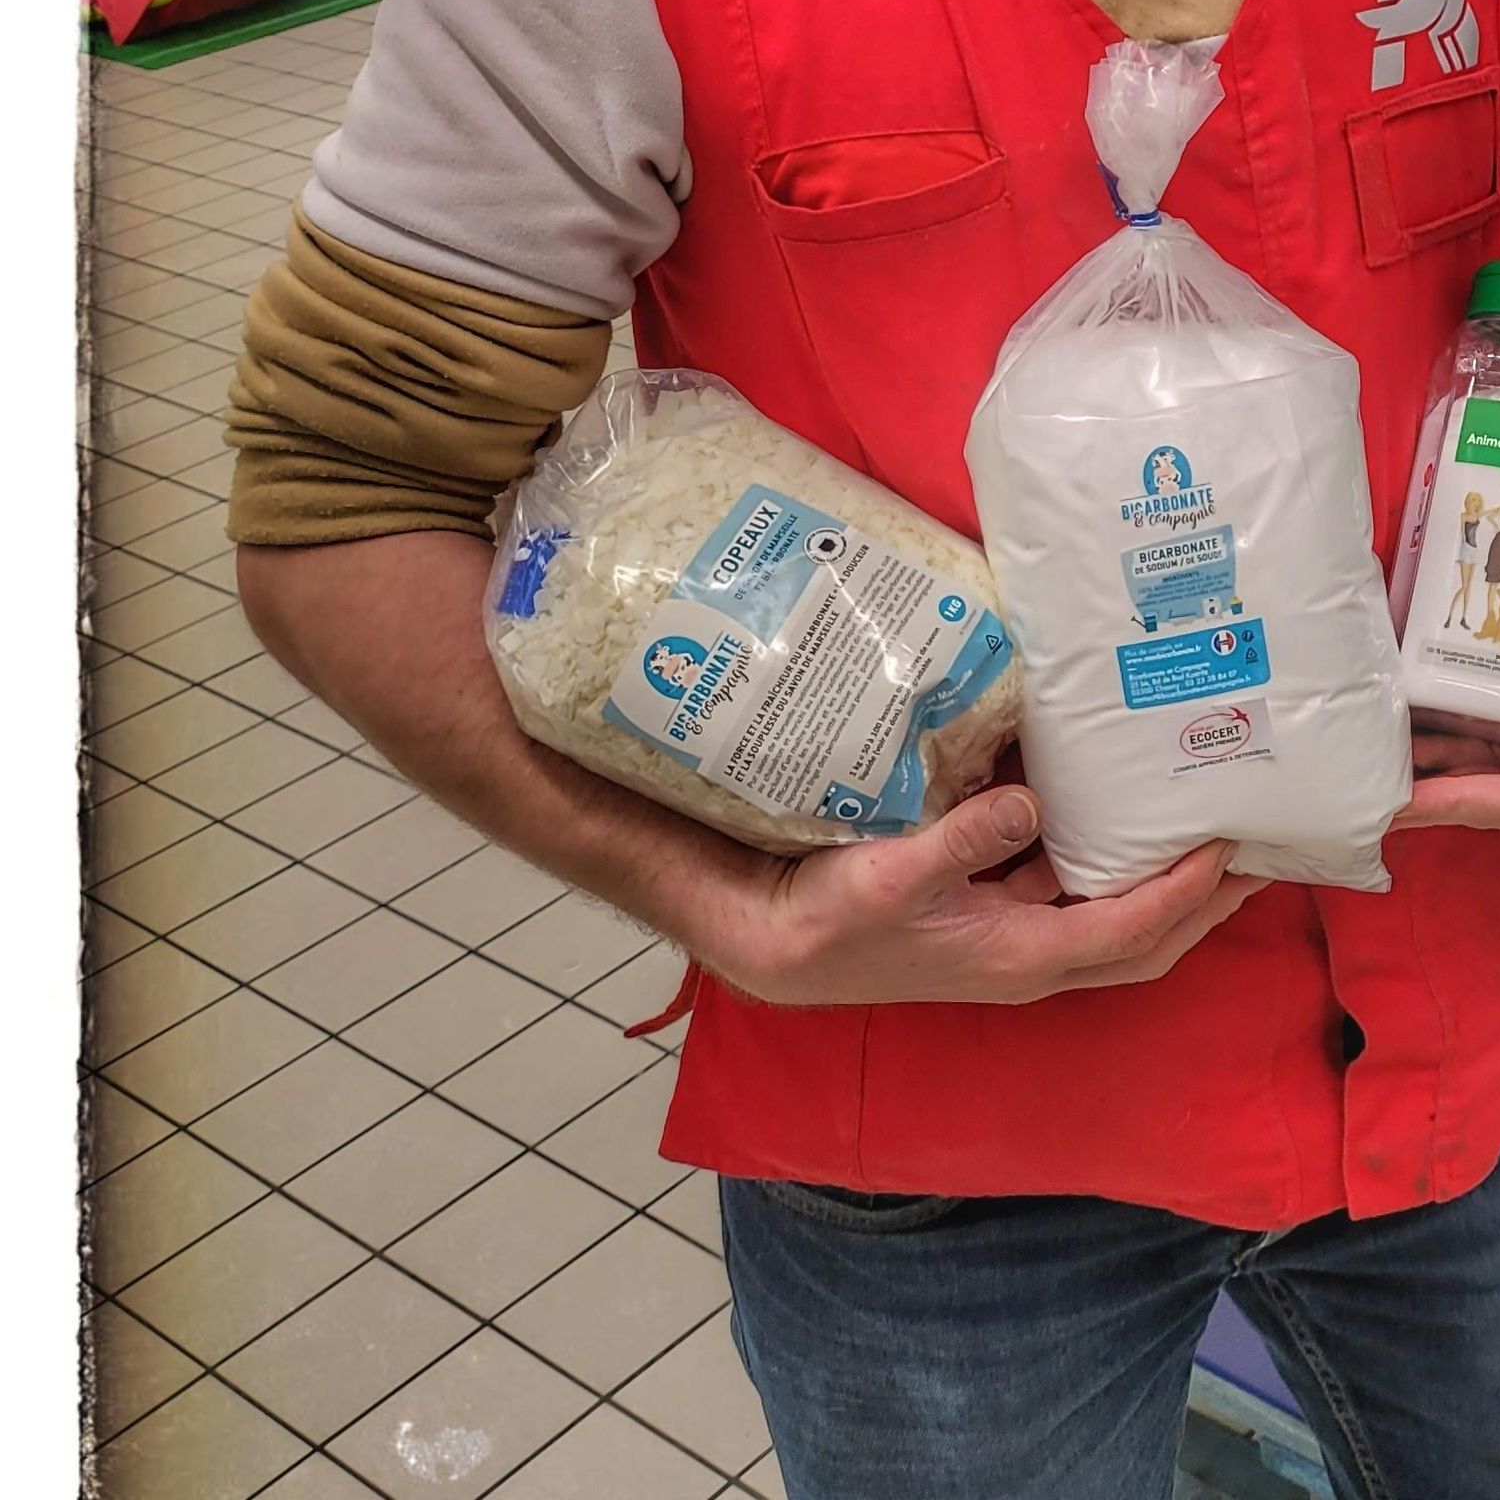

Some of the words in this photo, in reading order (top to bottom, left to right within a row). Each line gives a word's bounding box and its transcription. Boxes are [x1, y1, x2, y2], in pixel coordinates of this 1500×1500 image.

[1121, 488, 1214, 520] BICARBONATE
[1149, 503, 1216, 531] compagnie
[712, 506, 779, 585] COPEAUX
[767, 511, 798, 553] MARSEILLE
[842, 542, 870, 579] DOUCEUR
[1139, 537, 1218, 564] BICARBONATE
[1134, 566, 1144, 575] DE
[1145, 560, 1178, 573] SODIUM
[796, 592, 839, 652] BICARBONATE
[807, 609, 842, 656] MARSEILLE
[789, 650, 803, 666] DU
[801, 655, 814, 668] DE
[670, 634, 742, 741] BICARBONATE
[700, 644, 753, 720] compagnie
[758, 663, 795, 713] FRAÎCHEUR
[783, 668, 806, 698] SAVON
[752, 711, 765, 725] LA
[775, 696, 789, 712] DU
[746, 724, 758, 736] ET
[746, 710, 782, 759] SOUPLESSE
[1189, 725, 1240, 745] ECOCERT
[729, 735, 752, 765] FORCE
[740, 757, 753, 771] LA
[723, 763, 736, 777] LA
[734, 770, 746, 783] ET
